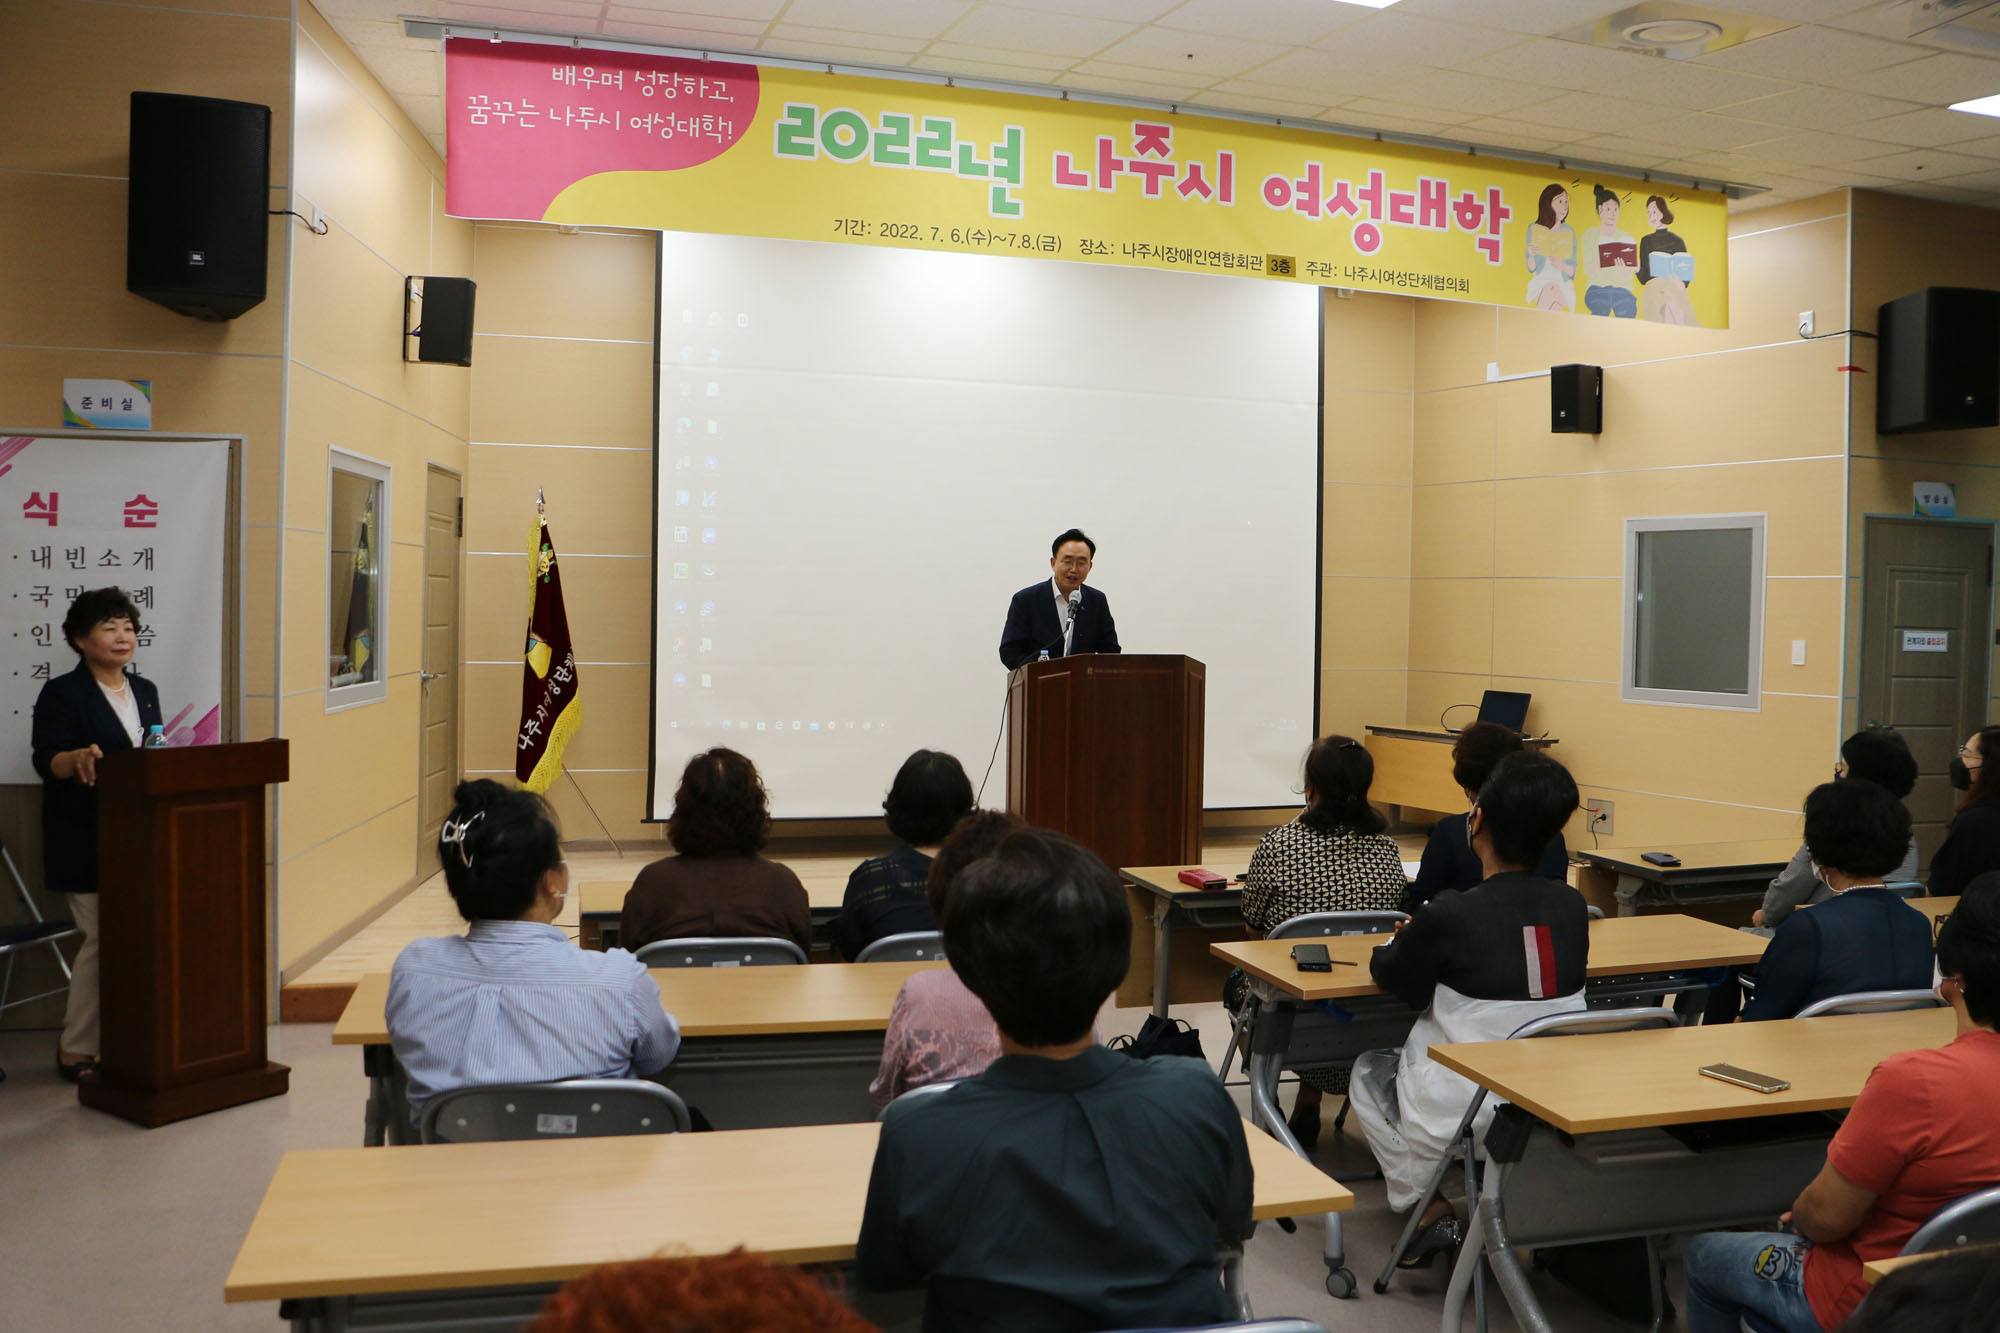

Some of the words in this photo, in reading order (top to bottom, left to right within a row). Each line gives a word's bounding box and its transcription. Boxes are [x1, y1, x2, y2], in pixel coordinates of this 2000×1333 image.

[552, 65, 623, 90] 배우며
[634, 70, 734, 103] 성장하고,
[467, 95, 540, 128] 꿈꾸는
[549, 105, 620, 130] 나주시
[630, 111, 733, 144] 여성대학!
[776, 104, 1023, 217] 2022년
[1055, 122, 1234, 204] 나주시
[1262, 162, 1511, 264] 여성대학
[833, 218, 872, 237] 기간:
[879, 222, 923, 241] 2022.
[1079, 238, 1115, 256] 장소:
[1122, 242, 1263, 271] 나주시장애인연합회관
[1270, 258, 1292, 275] 3층
[1305, 260, 1338, 278] 주관:
[1344, 265, 1470, 294] 나주시여성단체협의회
[81, 396, 133, 411] 준비실
